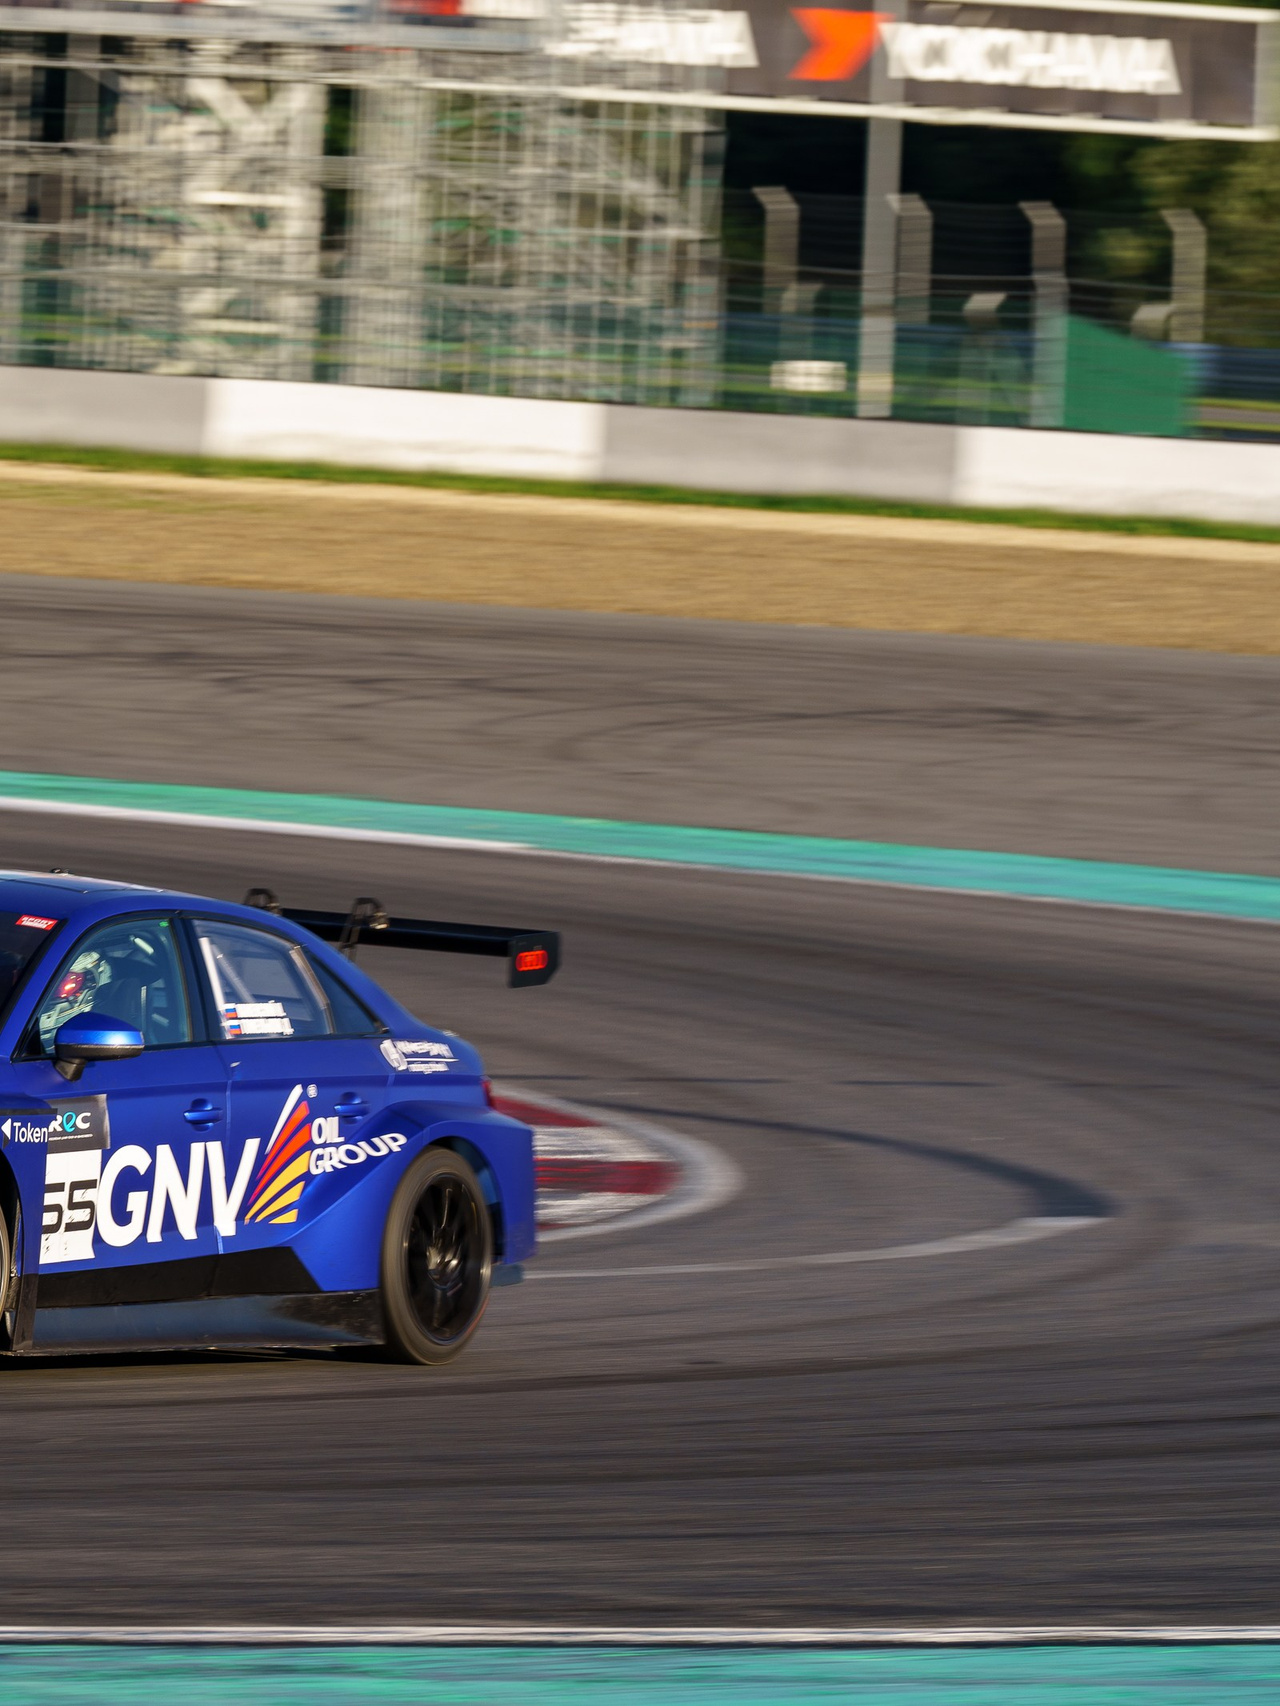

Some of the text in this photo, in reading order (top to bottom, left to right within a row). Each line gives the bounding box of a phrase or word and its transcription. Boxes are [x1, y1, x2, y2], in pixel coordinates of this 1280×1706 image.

[13, 1122, 48, 1143] Token
[311, 1116, 345, 1145] OIL
[309, 1133, 408, 1175] GROUP
[42, 1178, 98, 1235] 55
[96, 1137, 261, 1247] GNV
